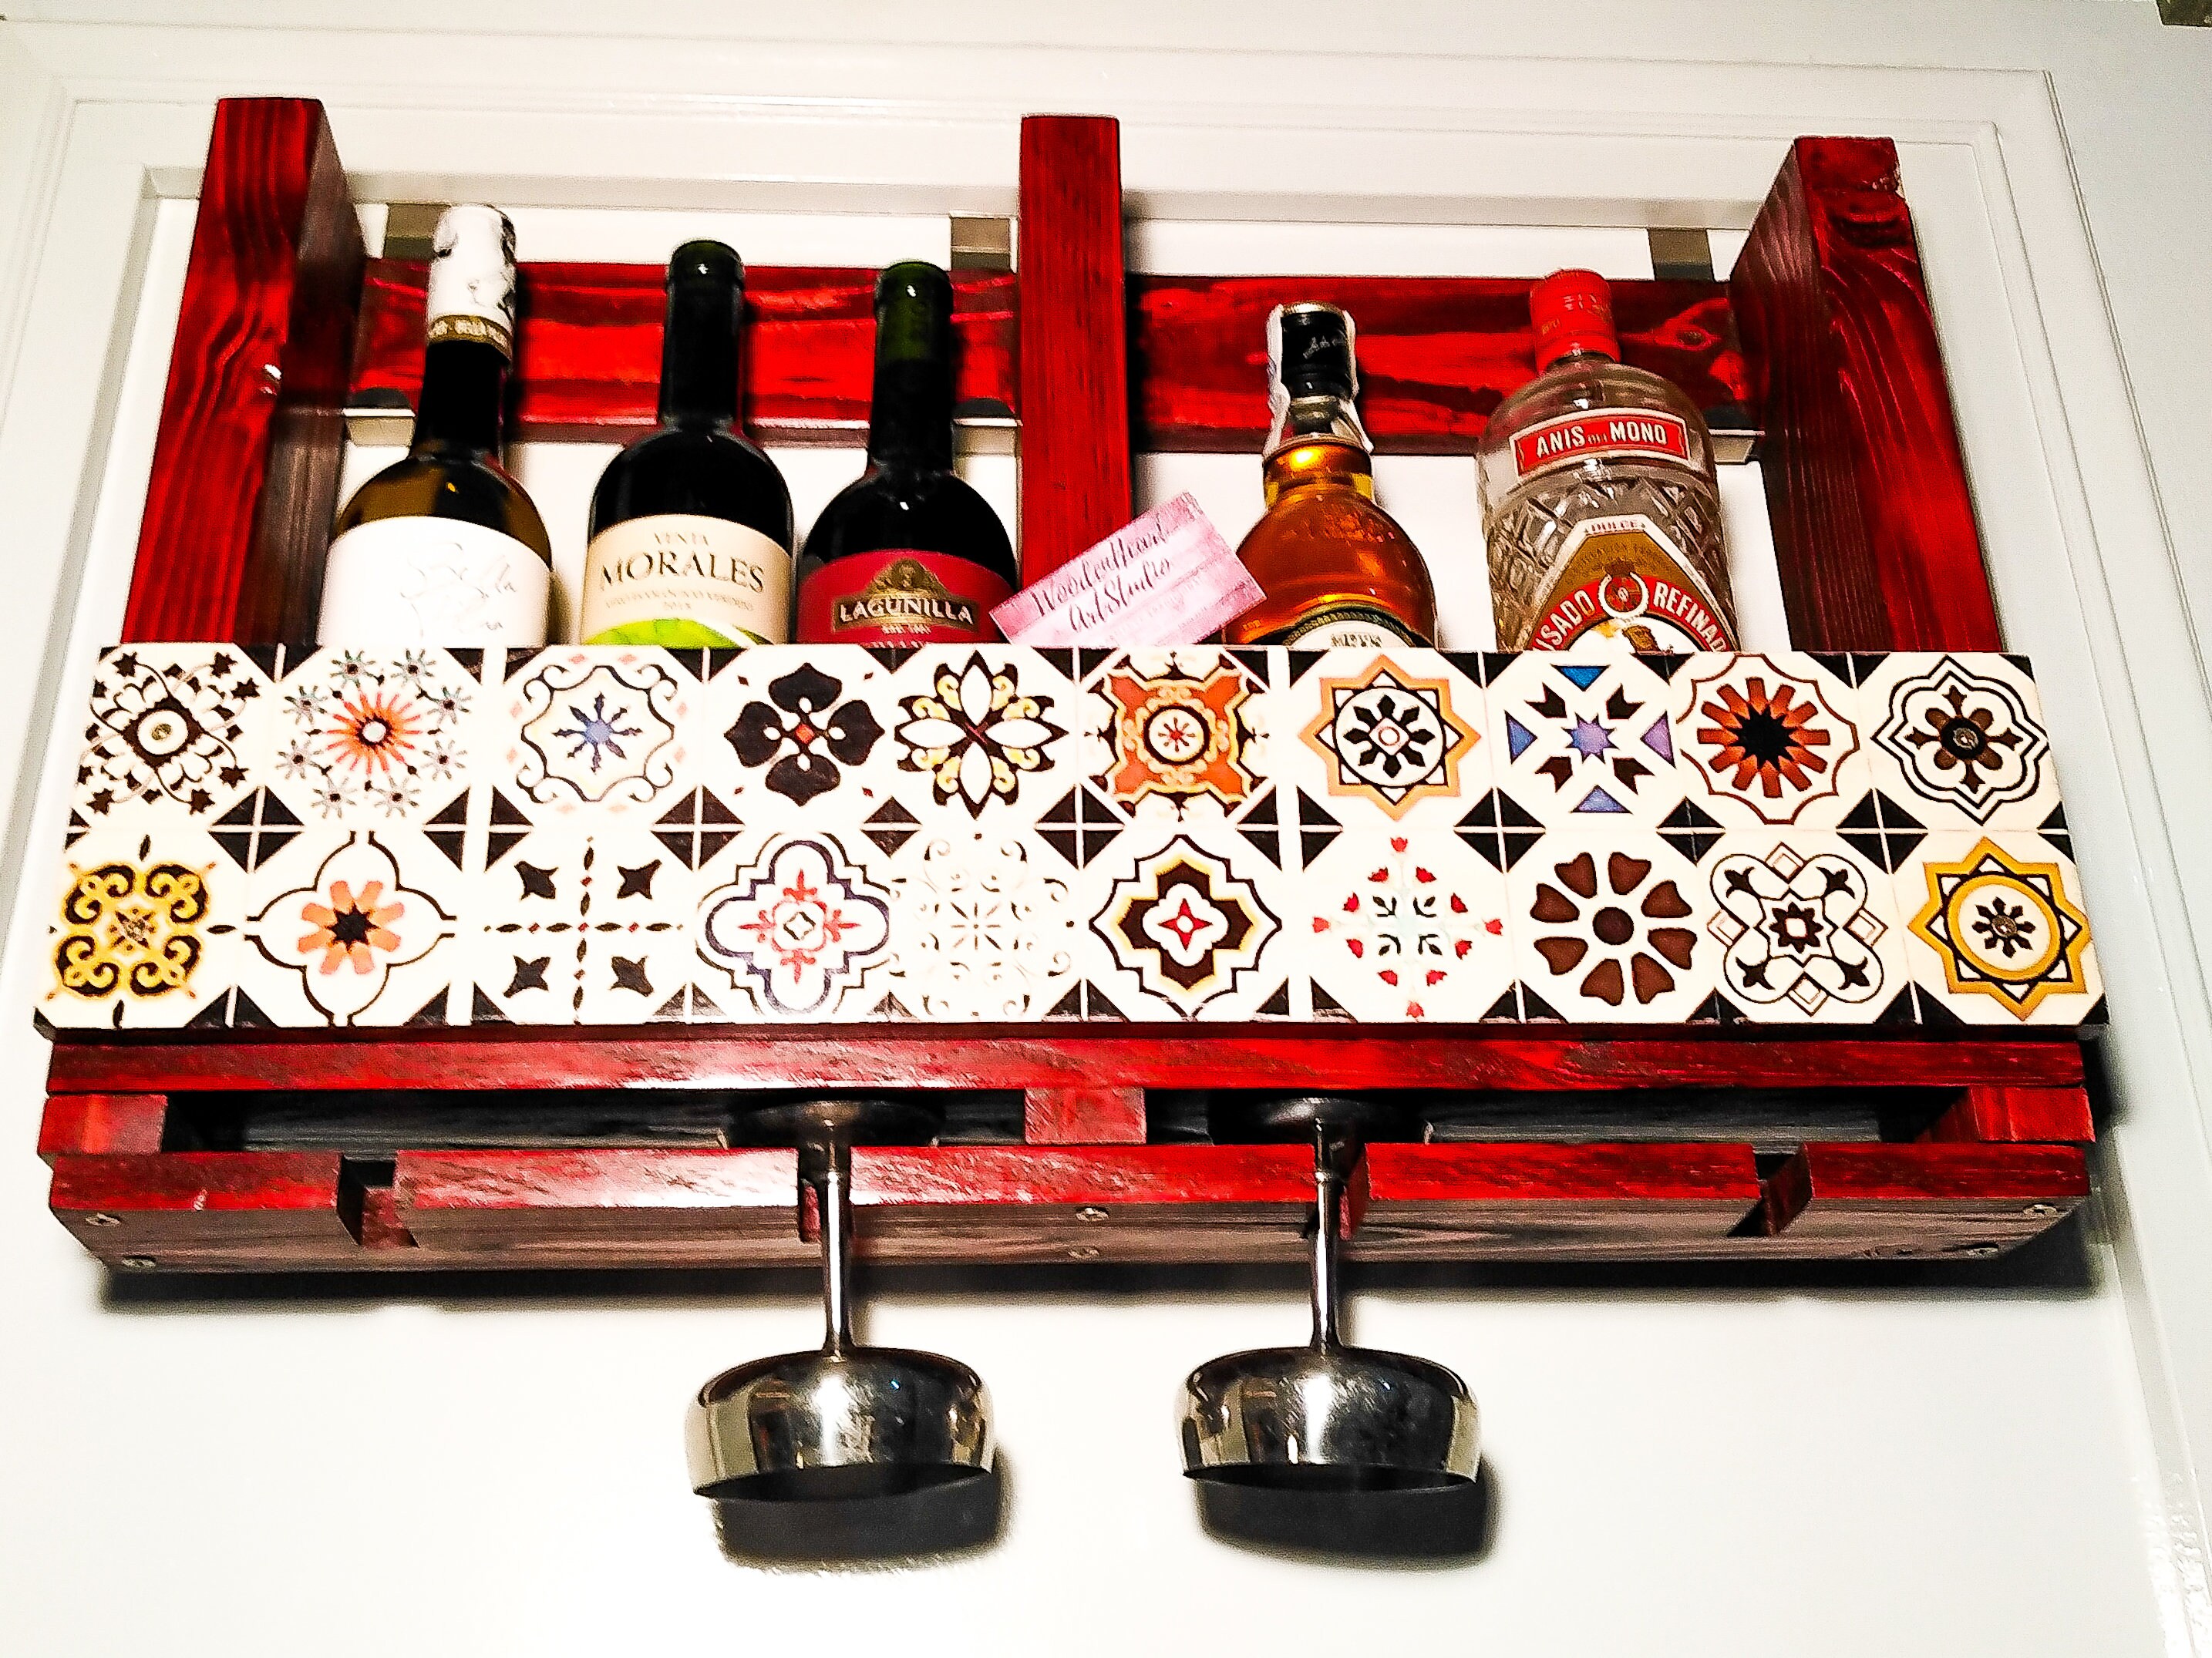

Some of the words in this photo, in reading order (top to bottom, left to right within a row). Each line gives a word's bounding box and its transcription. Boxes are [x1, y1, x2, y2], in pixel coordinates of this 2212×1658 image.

[1537, 425, 1585, 458] ANIS
[1609, 421, 1668, 446] MONO
[600, 550, 765, 594] MORALES
[840, 597, 974, 625] LAGUNILLA
[1532, 590, 1596, 651] ISADO
[1653, 581, 1727, 652] REFINAD
